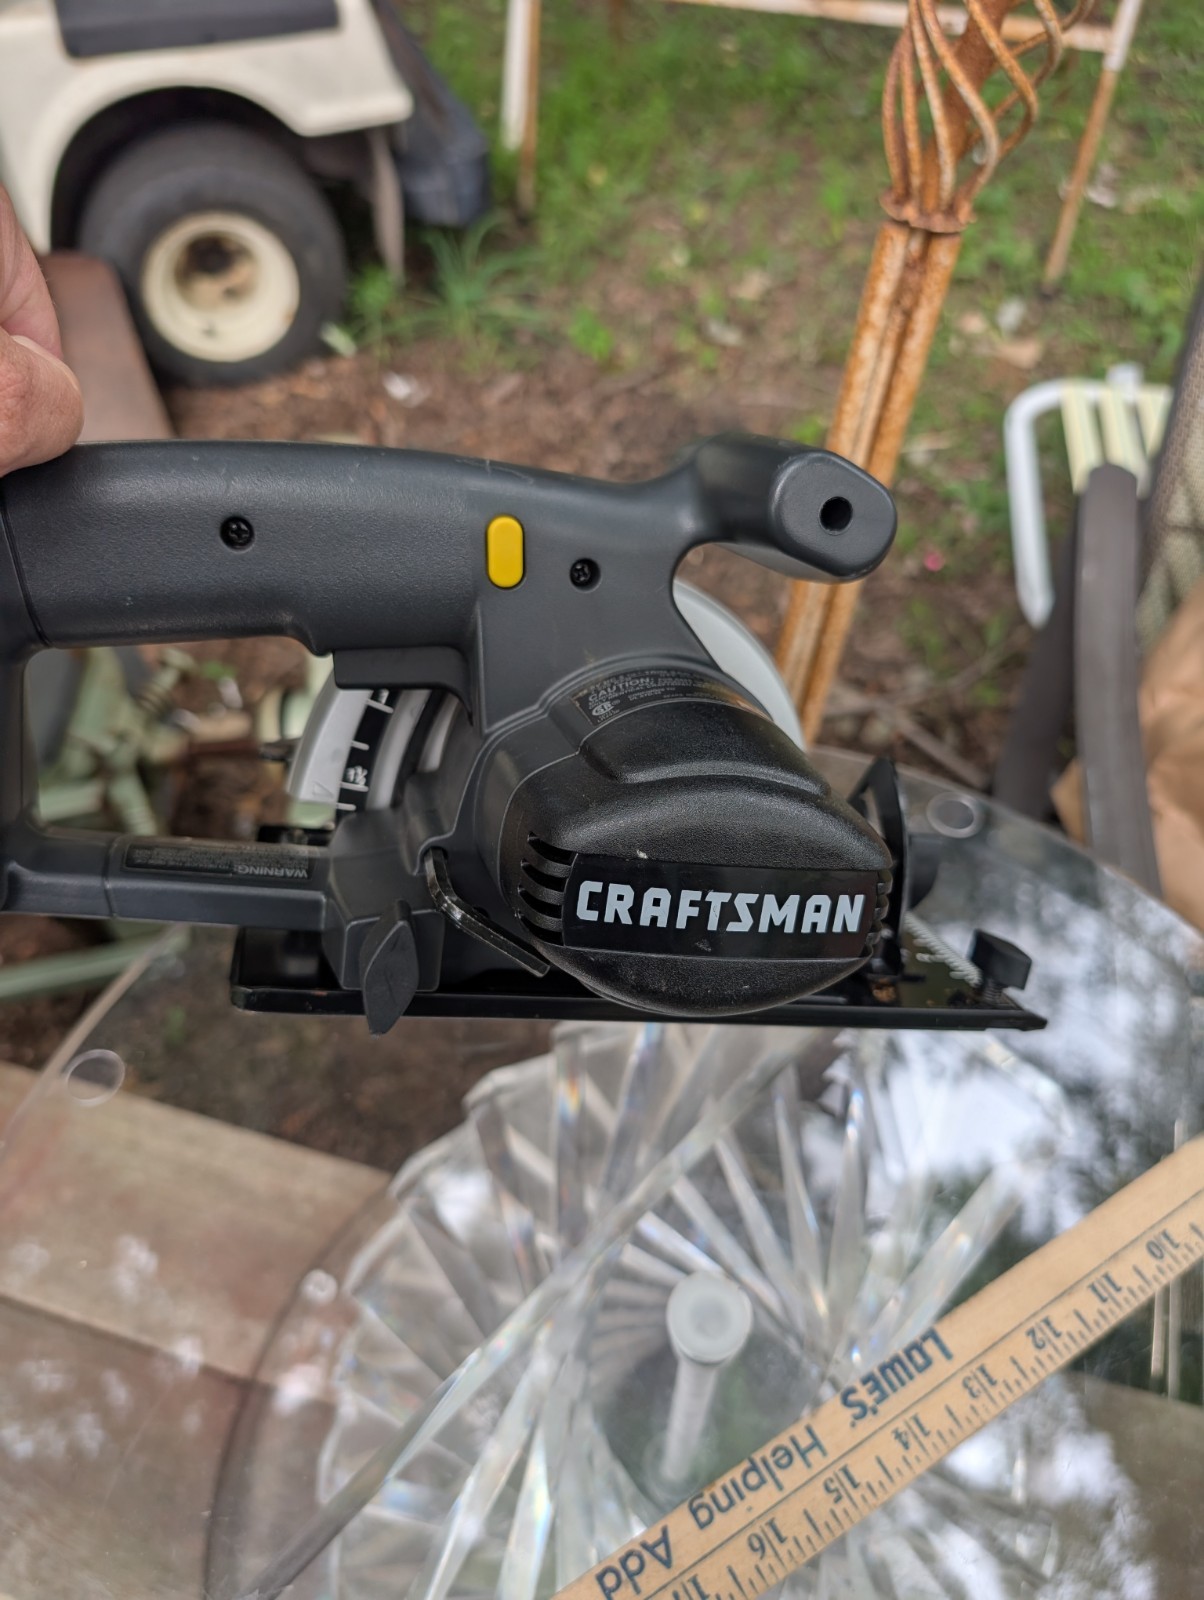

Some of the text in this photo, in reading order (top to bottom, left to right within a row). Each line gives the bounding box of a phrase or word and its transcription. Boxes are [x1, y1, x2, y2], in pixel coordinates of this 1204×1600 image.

[233, 864, 308, 878] WARNING:
[576, 880, 865, 934] CRAFTSMAN
[1145, 1228, 1181, 1262] 10
[1086, 1273, 1123, 1303] 11
[1025, 1315, 1063, 1351] 12
[962, 1363, 999, 1399] 13
[891, 1412, 931, 1451] 14
[595, 1327, 954, 1600] LOWE'S Helping Add
[823, 1464, 862, 1504] 15
[747, 1519, 788, 1560] 16
